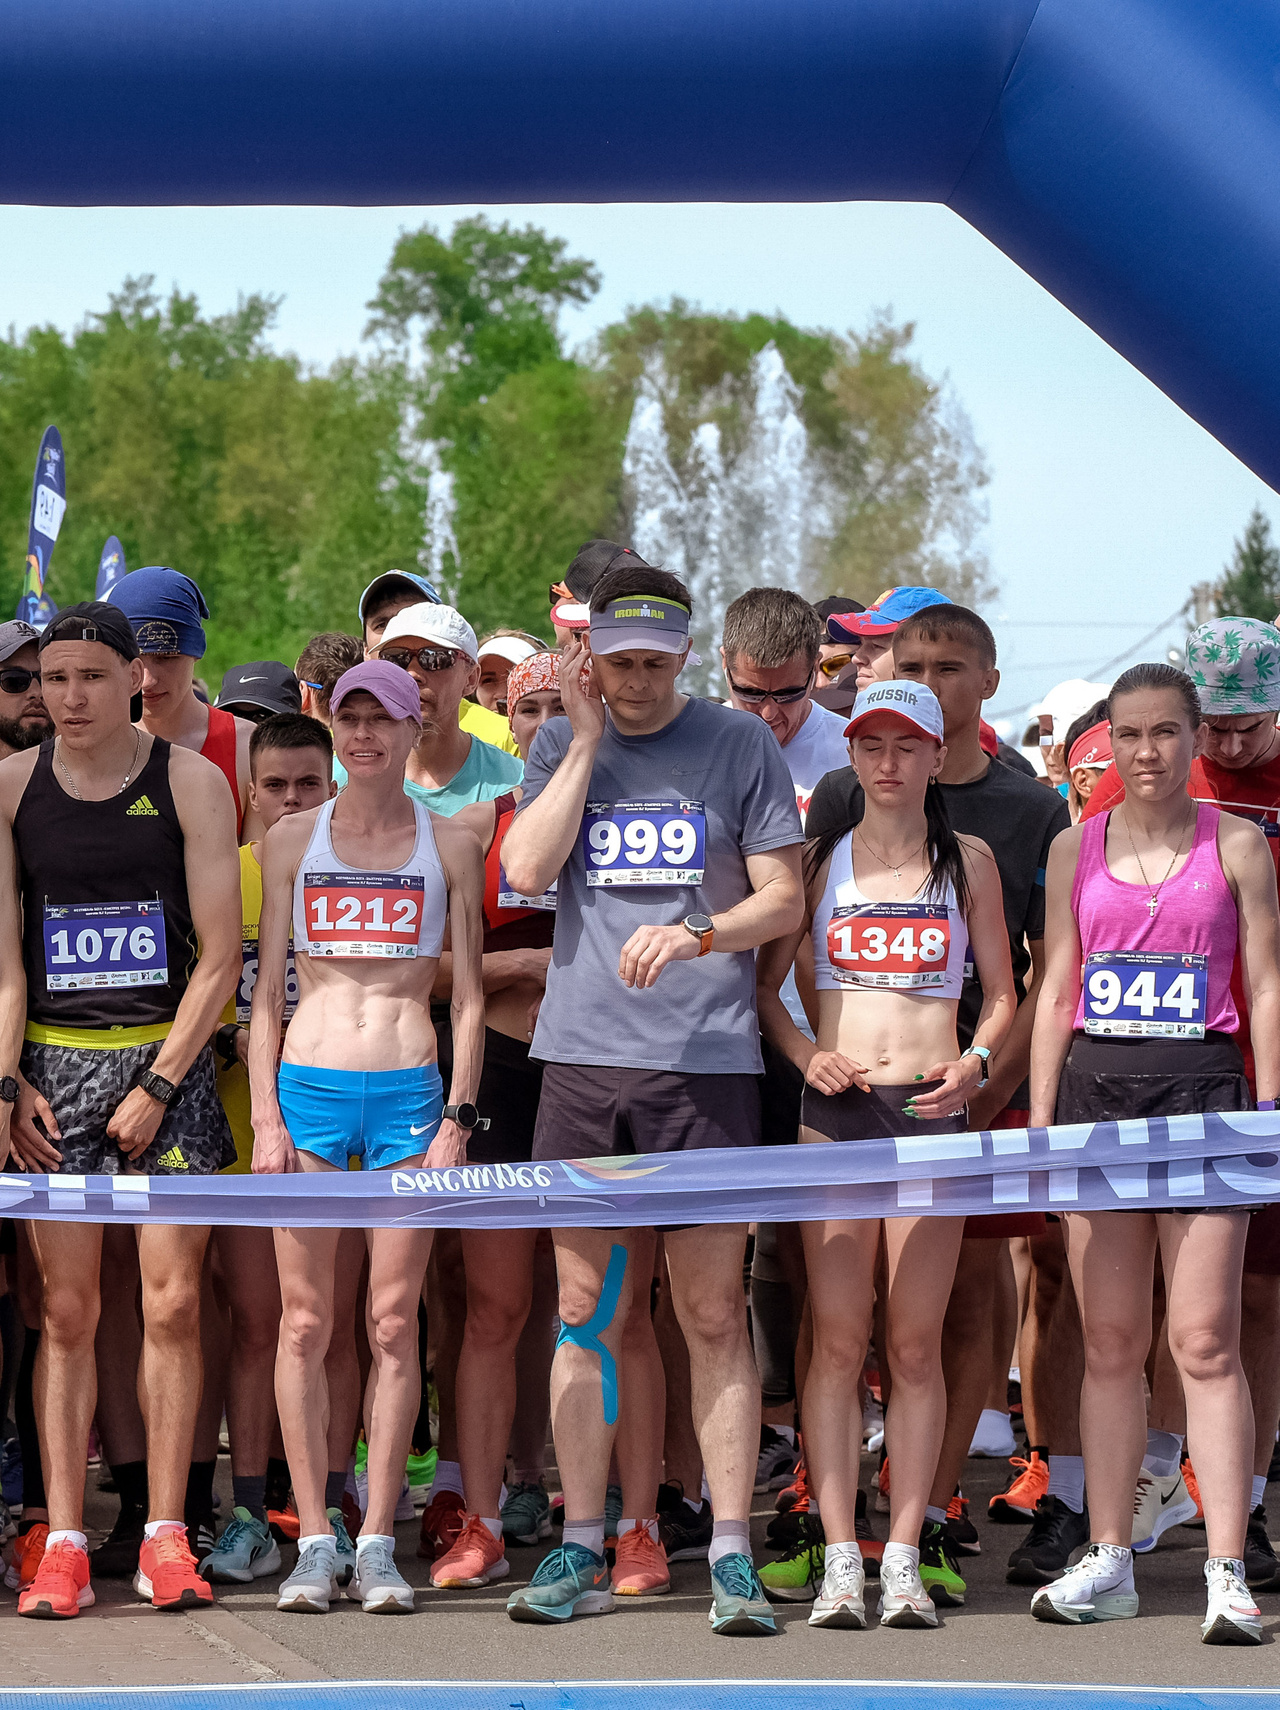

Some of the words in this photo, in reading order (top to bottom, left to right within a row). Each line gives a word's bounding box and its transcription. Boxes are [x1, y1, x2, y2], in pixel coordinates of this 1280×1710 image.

[614, 603, 665, 620] IRONMAN
[867, 688, 918, 706] RUSSIA
[126, 807, 159, 816] adidas
[589, 819, 697, 866] 999
[310, 896, 418, 933] 1212
[51, 926, 157, 964] 1076
[833, 926, 946, 963] 1348
[1088, 969, 1200, 1018] 944
[157, 1158, 189, 1169] adidas
